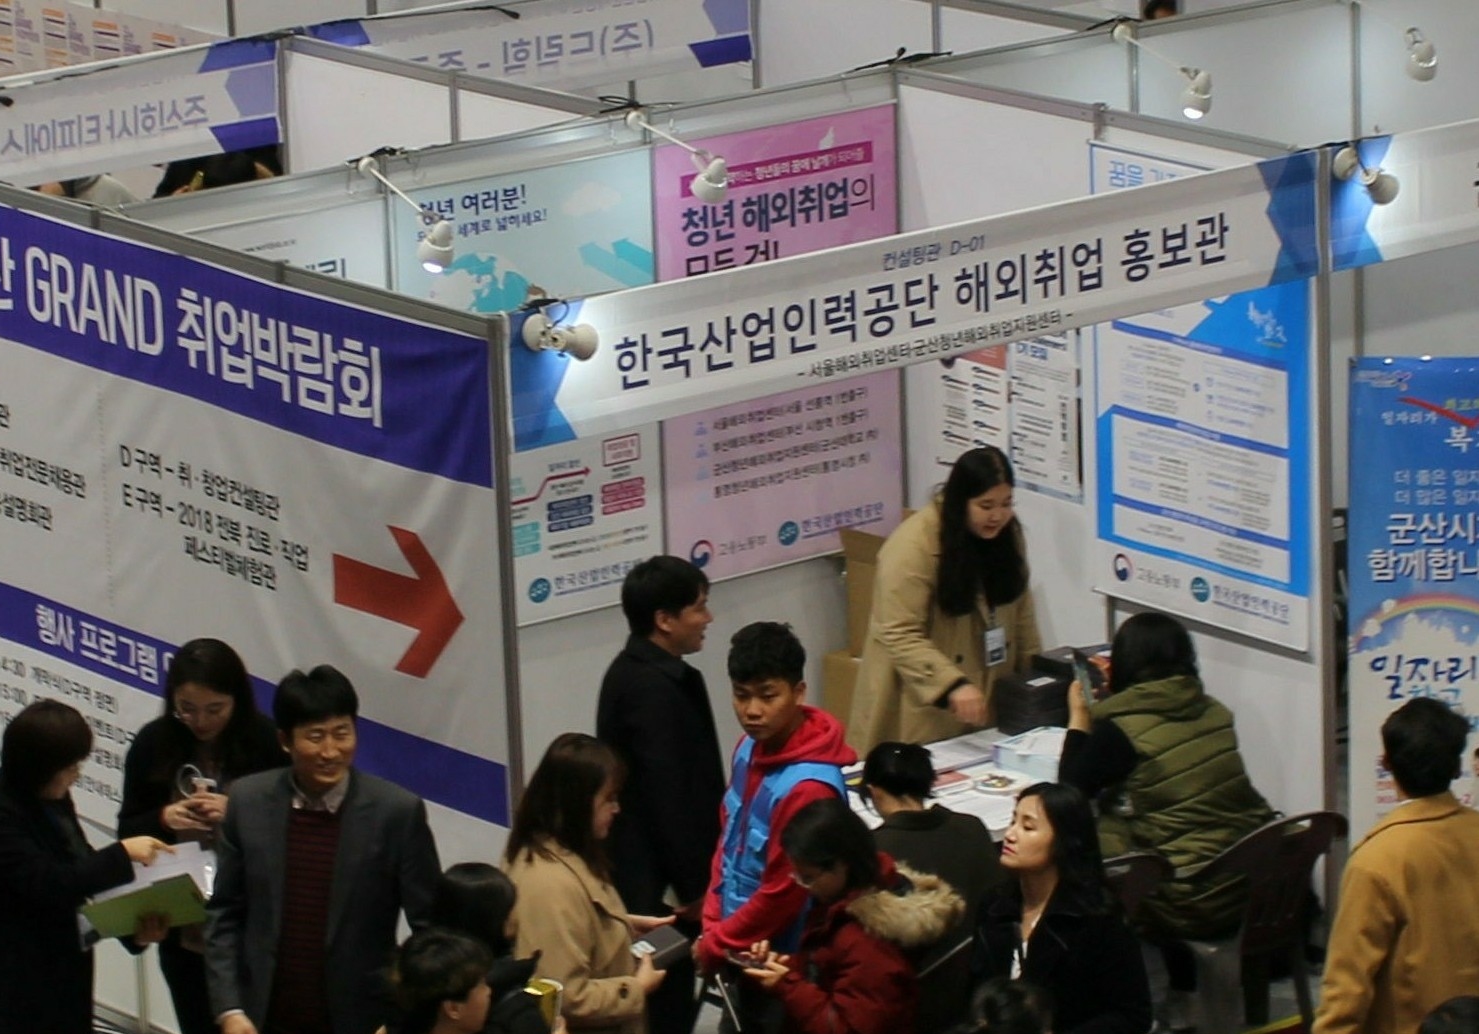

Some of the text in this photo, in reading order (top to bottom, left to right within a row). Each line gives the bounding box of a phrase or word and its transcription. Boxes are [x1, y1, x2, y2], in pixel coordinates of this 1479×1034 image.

[461, 184, 527, 217] 여러분!
[495, 208, 548, 232] 넓히세요!
[681, 174, 875, 247] 청년 해외취업의
[882, 234, 986, 272] 컨설팅관 D-01
[614, 212, 1230, 390] 한국산업인력공단 해외취업 홍보관
[24, 246, 164, 356] GRAND
[176, 287, 383, 429] 취업박람회
[120, 444, 131, 468] D
[135, 448, 162, 479] 구역
[123, 483, 133, 508] E
[136, 487, 162, 518] 구역
[178, 501, 214, 534] 2018
[216, 514, 242, 547] 전북
[184, 535, 277, 591] 페스티벌체험관
[35, 603, 159, 686] 행사 프로그램
[1370, 654, 1478, 700] 일자리
